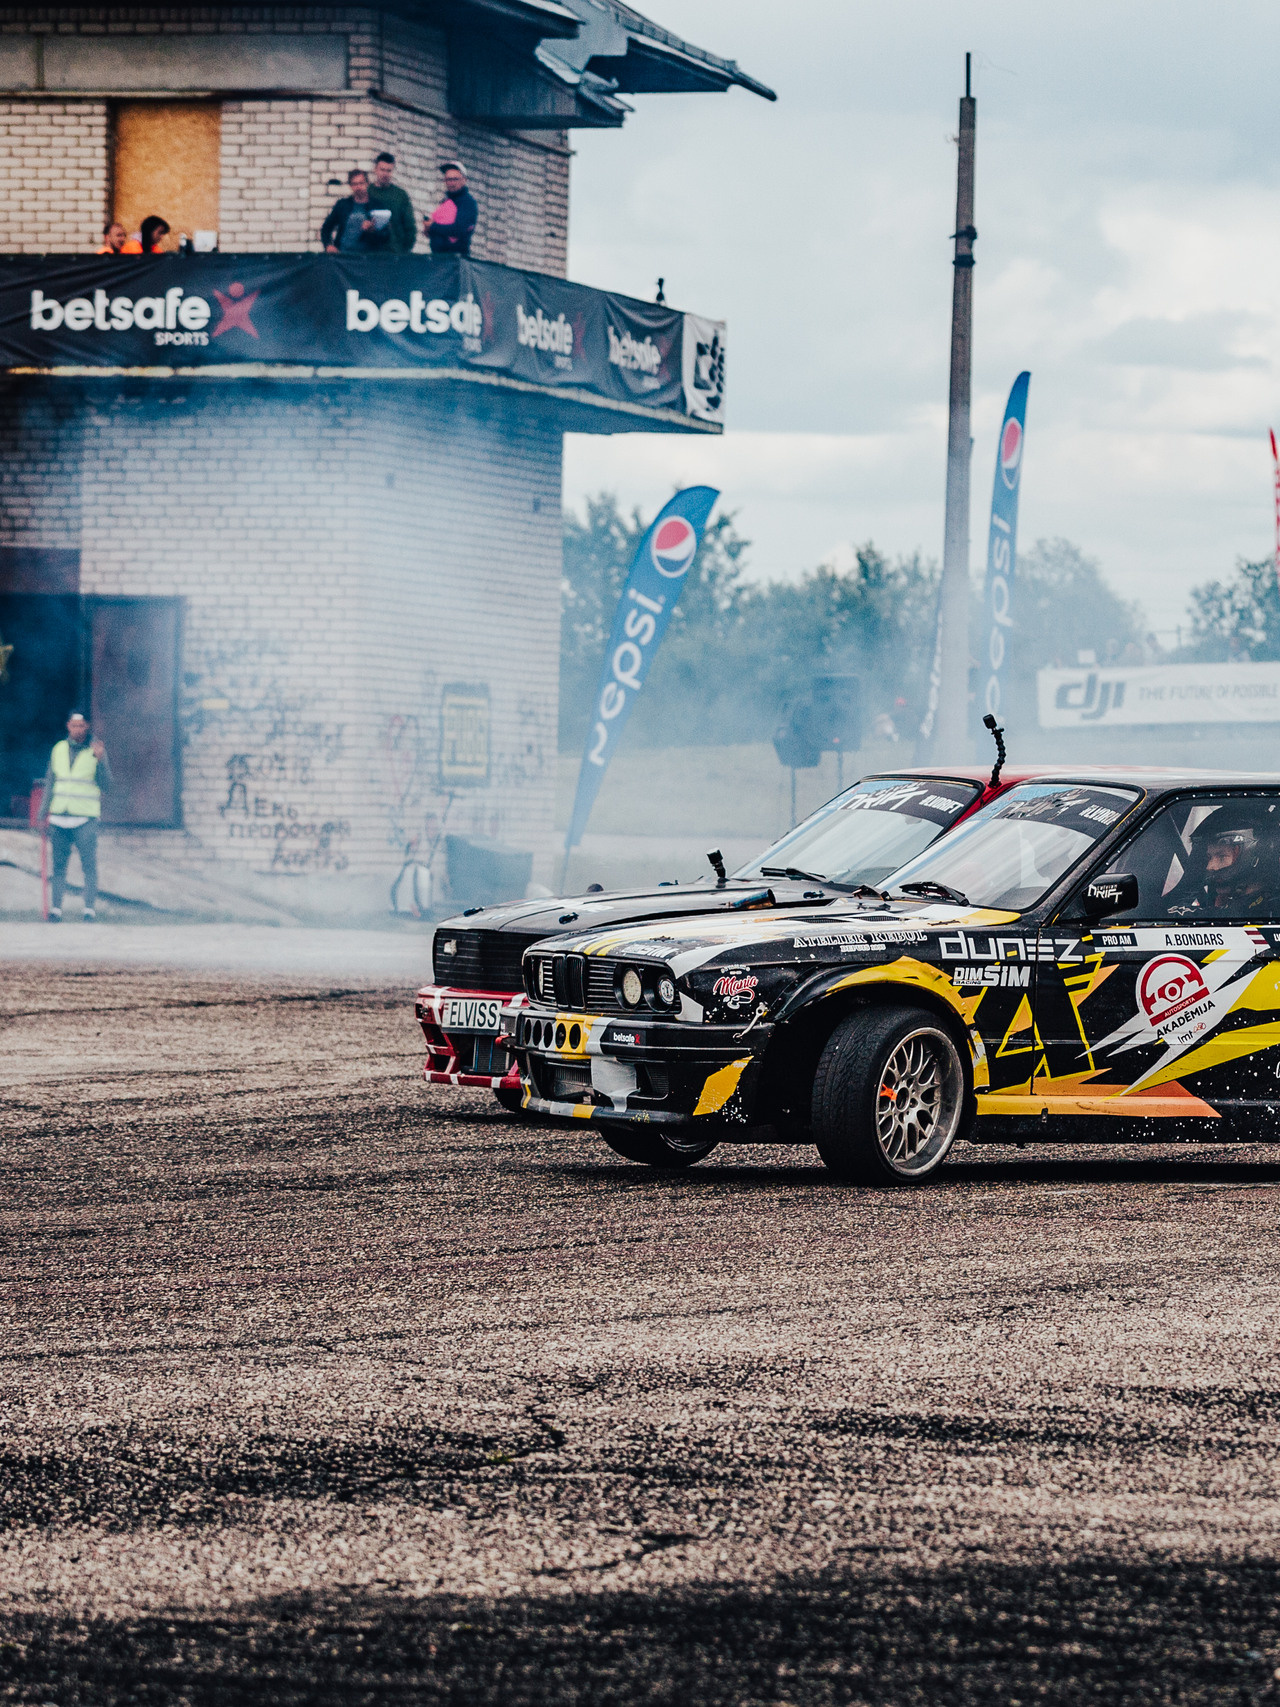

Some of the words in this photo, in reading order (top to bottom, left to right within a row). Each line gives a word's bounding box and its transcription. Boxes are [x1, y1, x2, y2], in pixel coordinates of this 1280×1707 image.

[30, 286, 211, 331] betsafe
[154, 331, 209, 347] SPORTS
[516, 304, 573, 355] betsafe
[1139, 685, 1165, 700] THE
[1087, 884, 1123, 904] DRIFT
[793, 933, 868, 949] ATELIER
[869, 929, 928, 944] REBUL
[1102, 935, 1117, 947] PRO
[1119, 935, 1133, 947] AM
[1165, 932, 1225, 947] A.BONDARS
[713, 975, 759, 997] Mania
[449, 1002, 498, 1028] ELVISS
[1164, 997, 1196, 1018] AUTOSPORTA
[1156, 1000, 1216, 1039] AKADĒMIJA
[613, 1032, 635, 1042] betsafe
